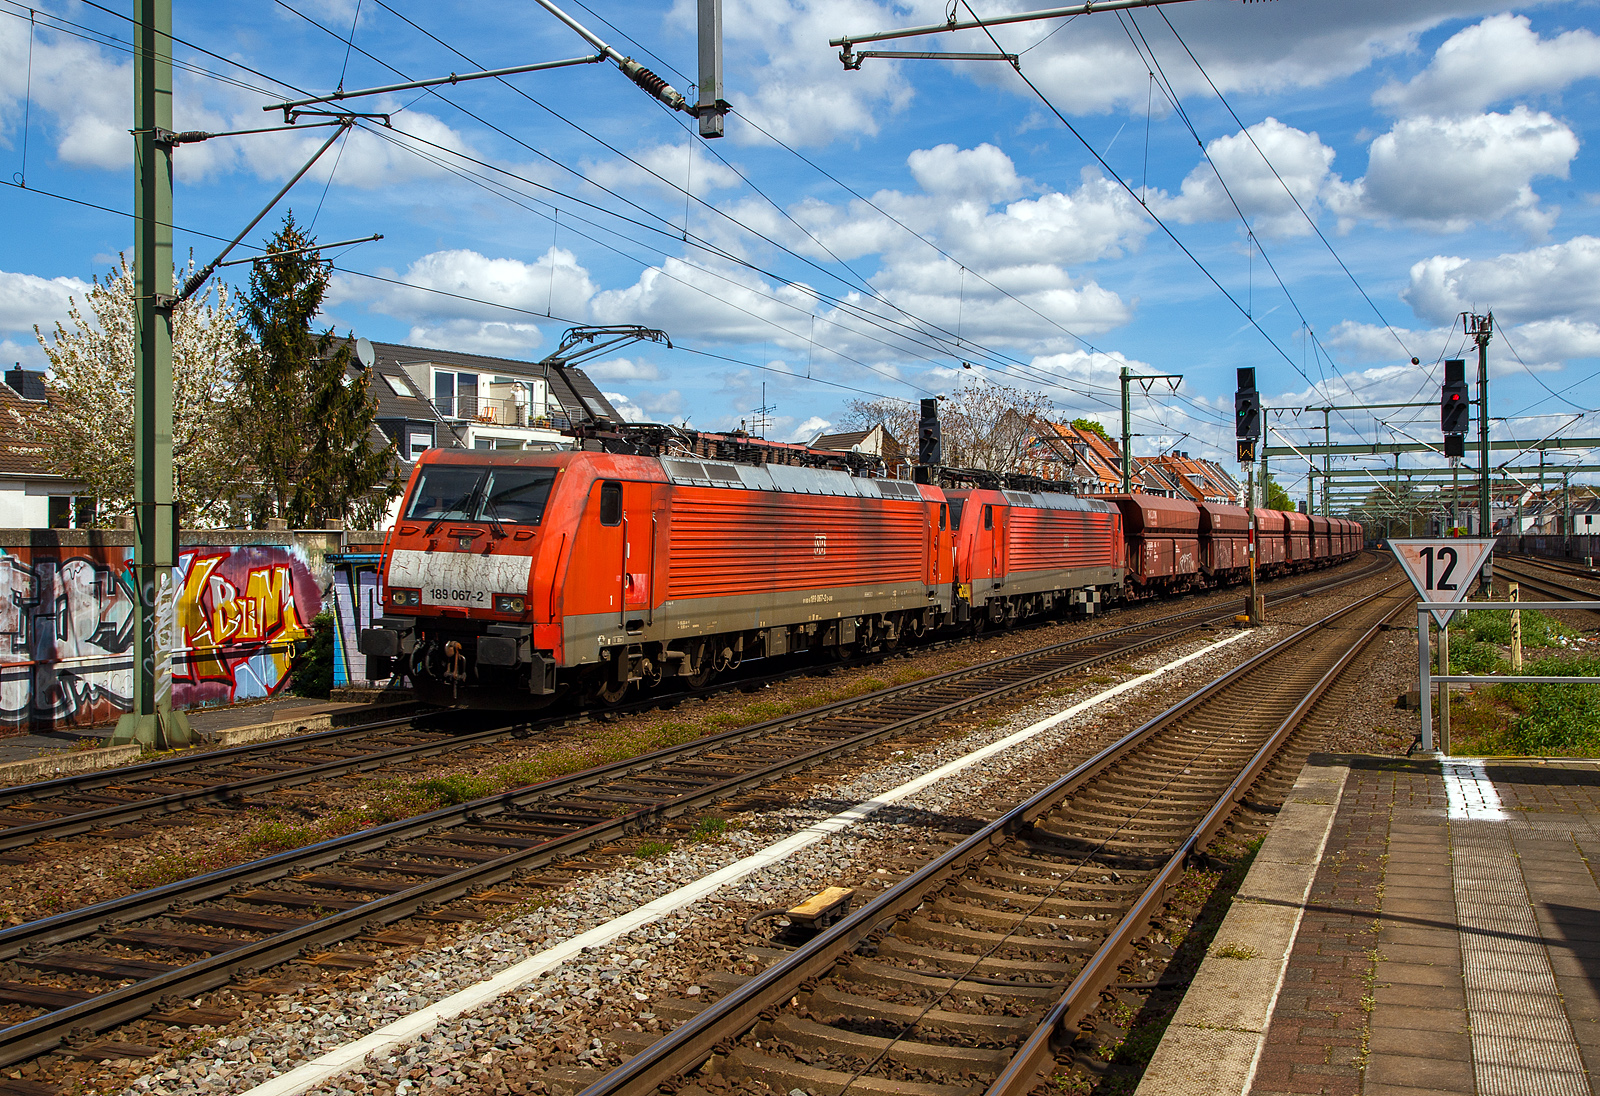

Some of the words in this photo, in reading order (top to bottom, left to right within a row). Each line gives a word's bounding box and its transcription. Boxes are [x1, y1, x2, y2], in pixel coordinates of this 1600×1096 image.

[1419, 546, 1458, 591] 12
[430, 588, 448, 600] 189
[451, 589, 484, 602] 067-2
[609, 595, 613, 606] 1
